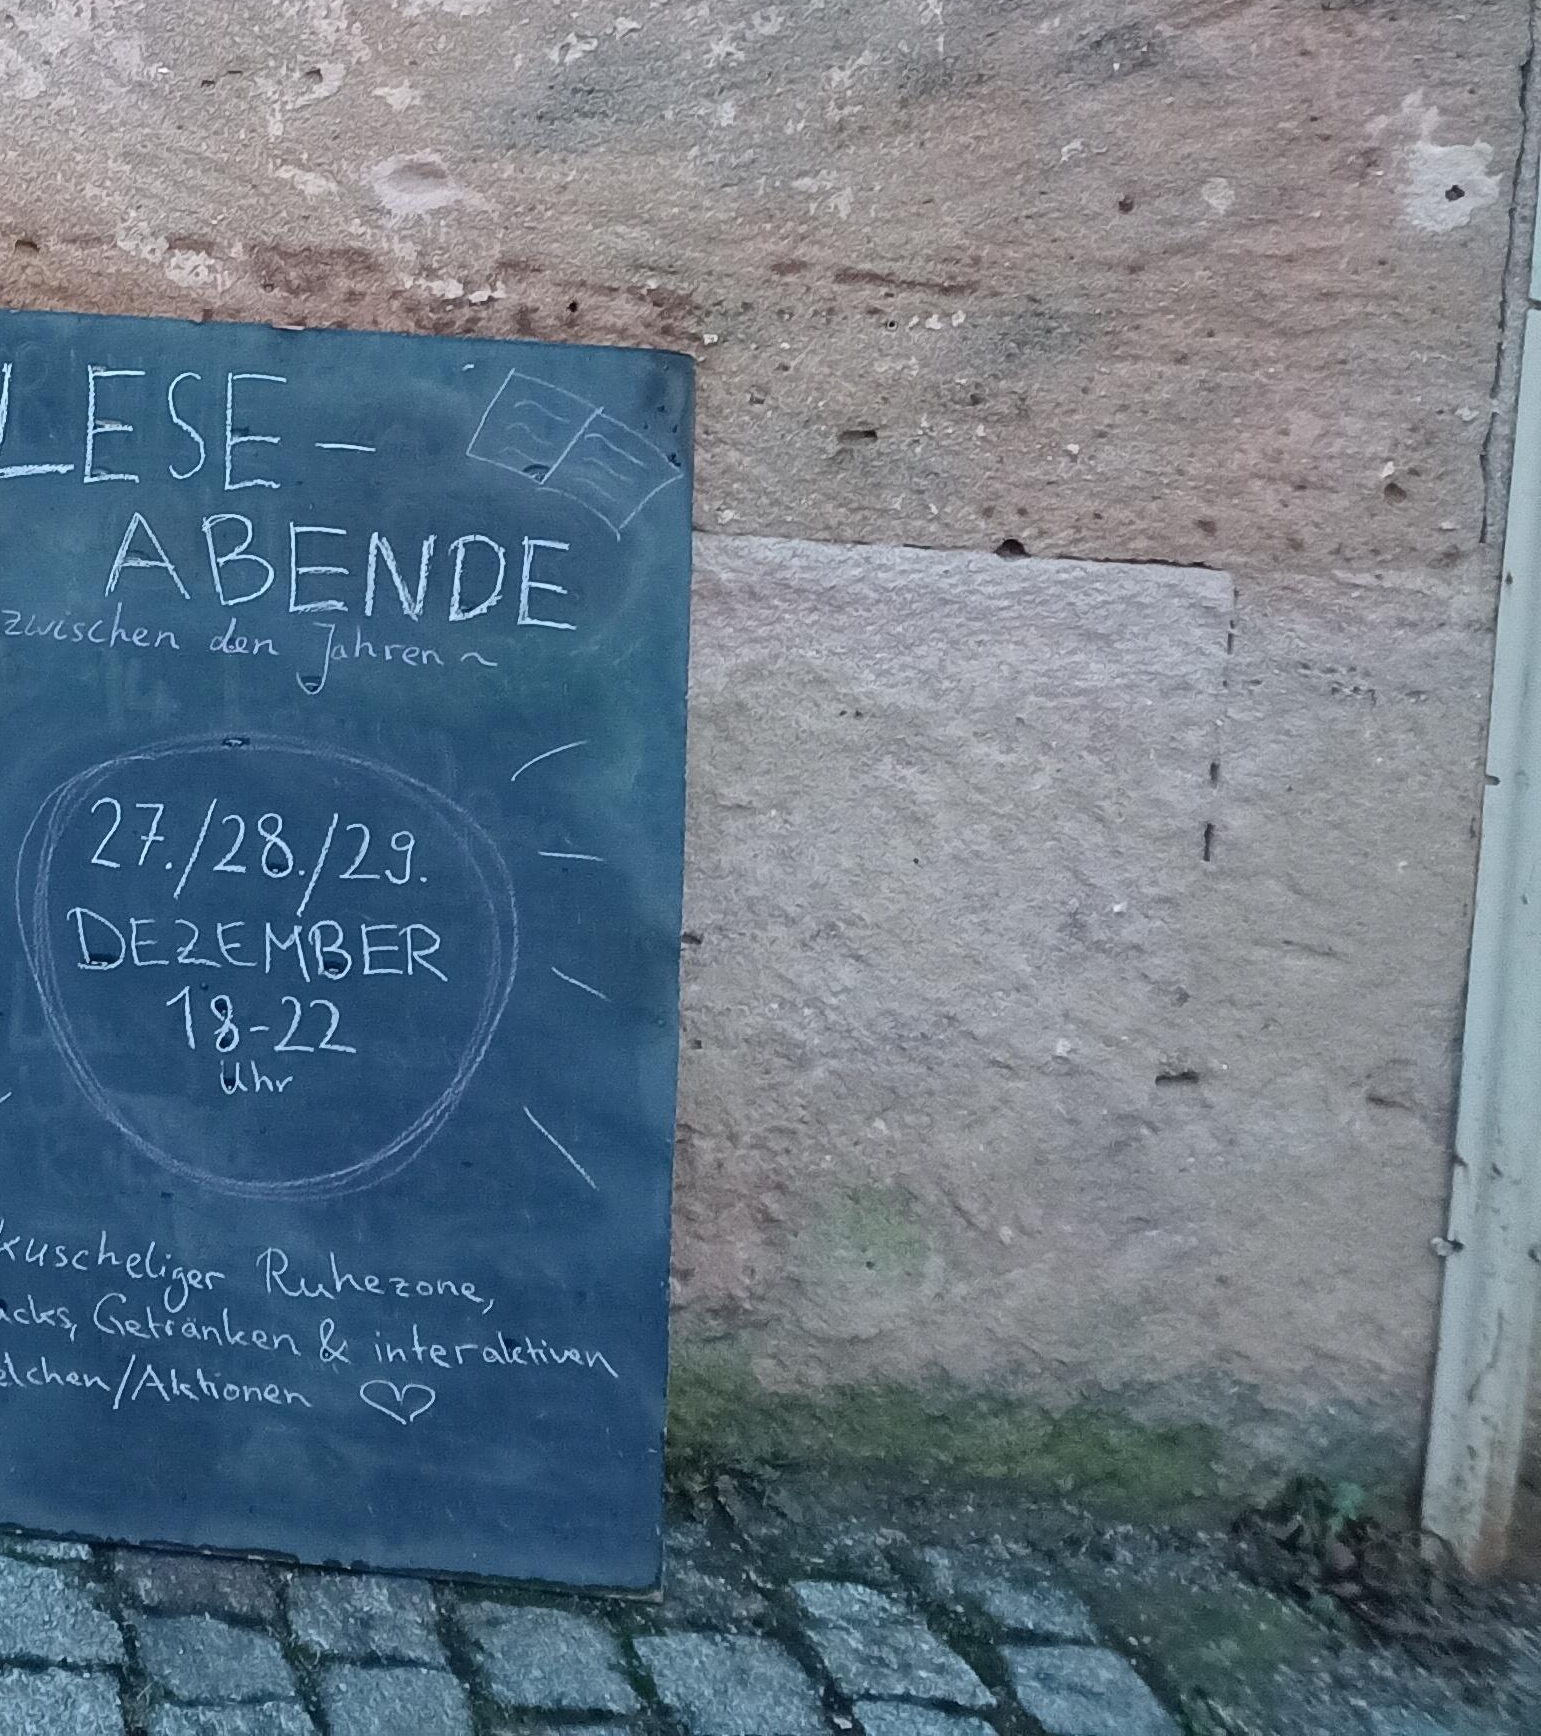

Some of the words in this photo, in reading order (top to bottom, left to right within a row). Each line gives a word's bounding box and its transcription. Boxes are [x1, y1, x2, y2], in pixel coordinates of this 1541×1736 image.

[105, 511, 577, 630] ABENDE
[209, 616, 280, 657] den
[90, 796, 428, 917] 27./28./29.
[66, 906, 449, 983] DEZEMBER
[166, 985, 357, 1054] 18-22
[218, 1060, 294, 1095] Uhr
[255, 1246, 495, 1316] Ruhezone,
[93, 1292, 301, 1356] Getränken
[318, 1317, 350, 1364] &
[373, 1323, 619, 1378] interaktiven
